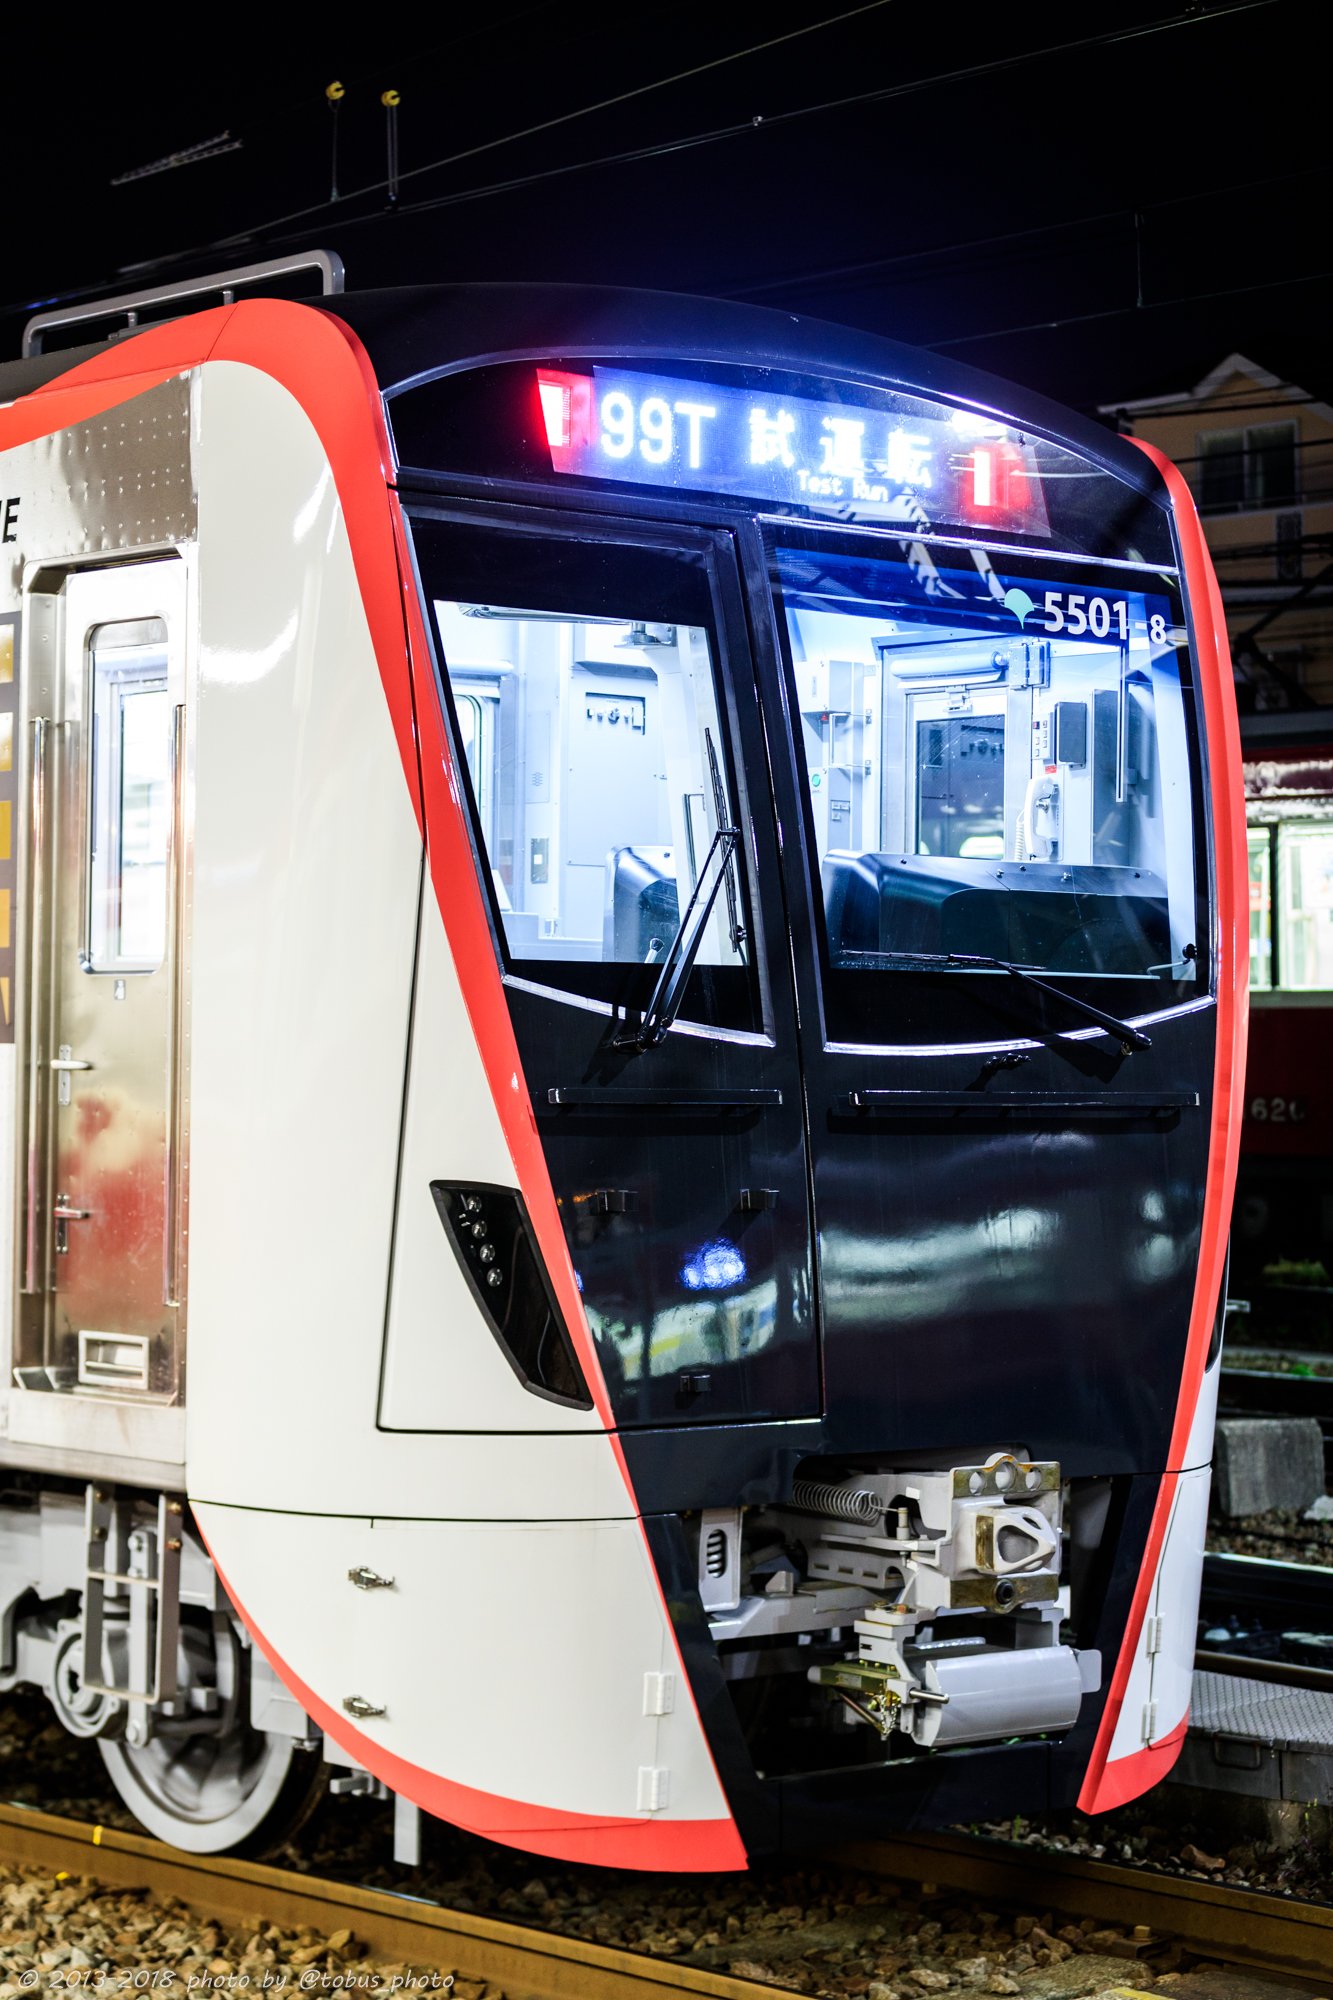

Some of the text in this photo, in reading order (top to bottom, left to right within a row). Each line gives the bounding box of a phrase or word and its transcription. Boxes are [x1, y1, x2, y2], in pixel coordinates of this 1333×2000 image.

[600, 391, 716, 469] 99T
[797, 469, 889, 502] Test Run
[1044, 591, 1167, 645] 5501-8
